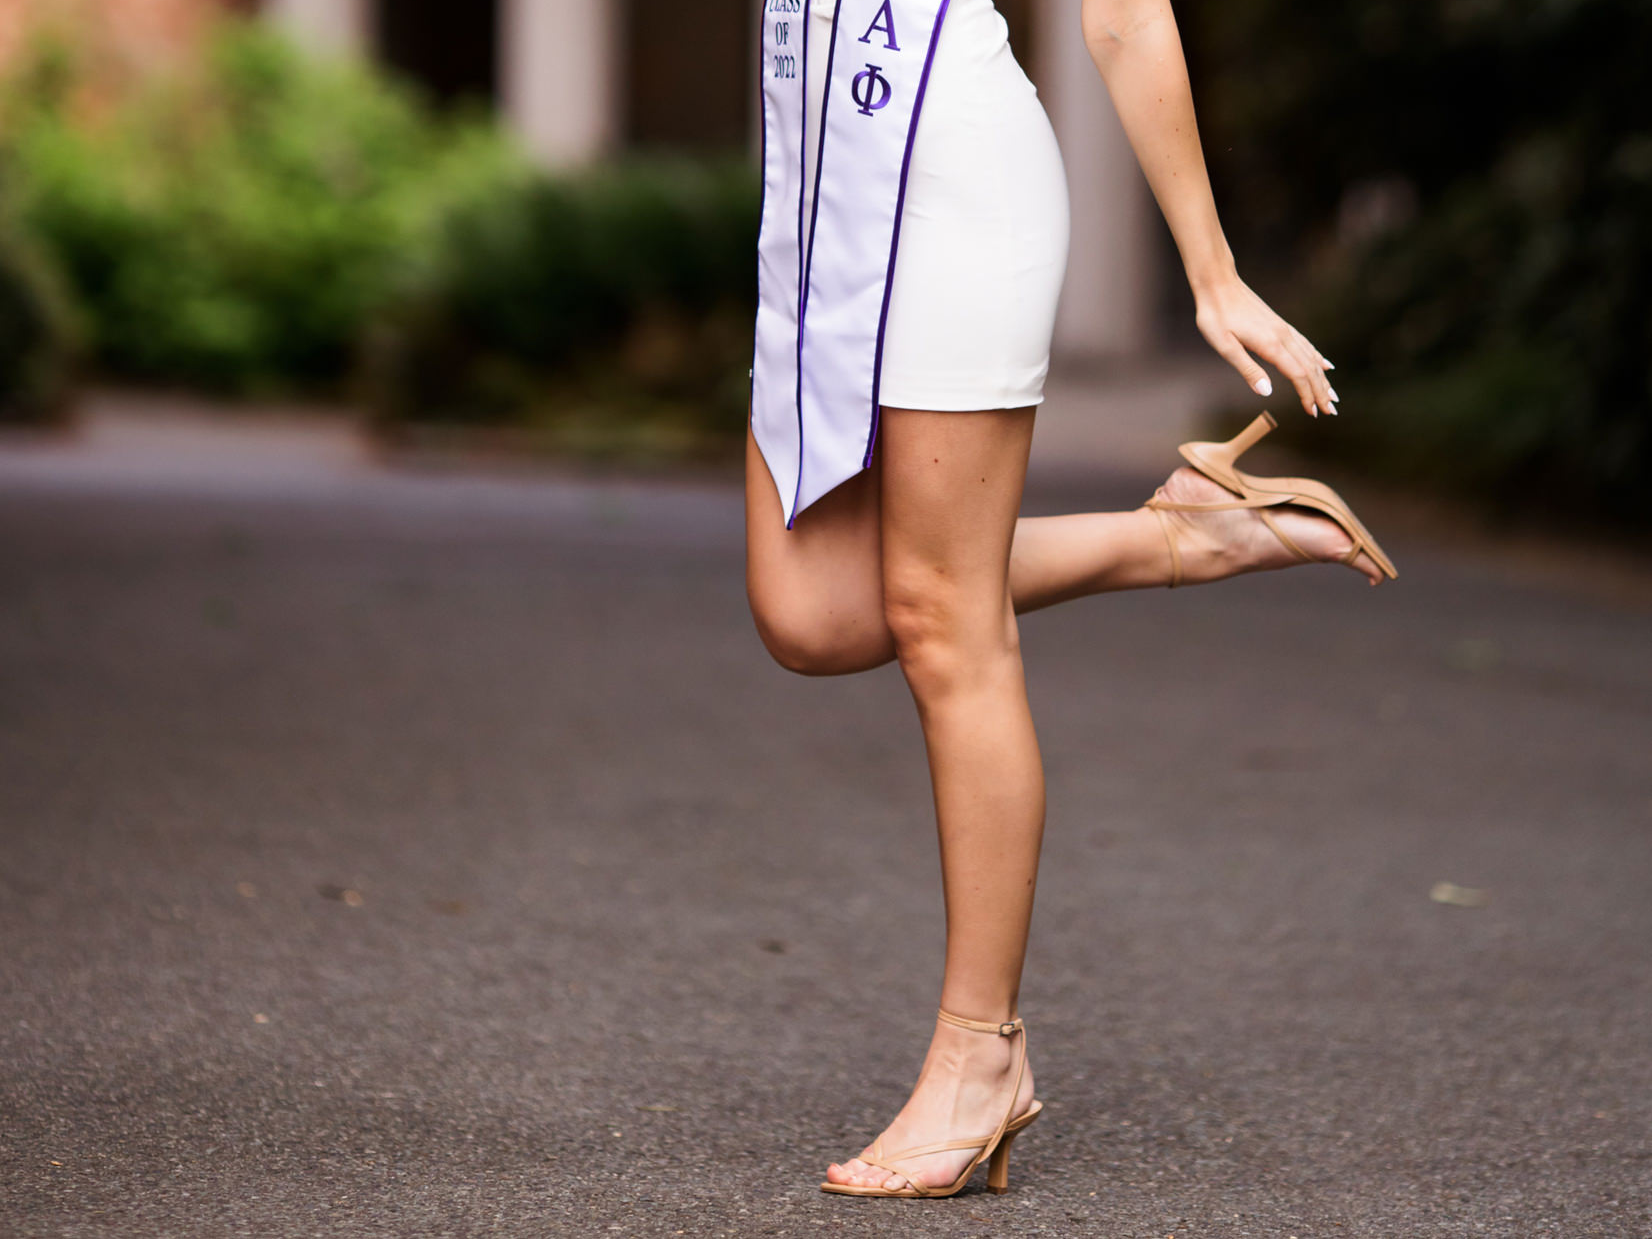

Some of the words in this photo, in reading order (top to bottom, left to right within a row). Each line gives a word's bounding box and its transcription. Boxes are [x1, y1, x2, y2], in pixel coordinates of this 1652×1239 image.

[775, 21, 789, 46] OF
[774, 54, 796, 79] 2022
[851, 63, 892, 117] Φ
